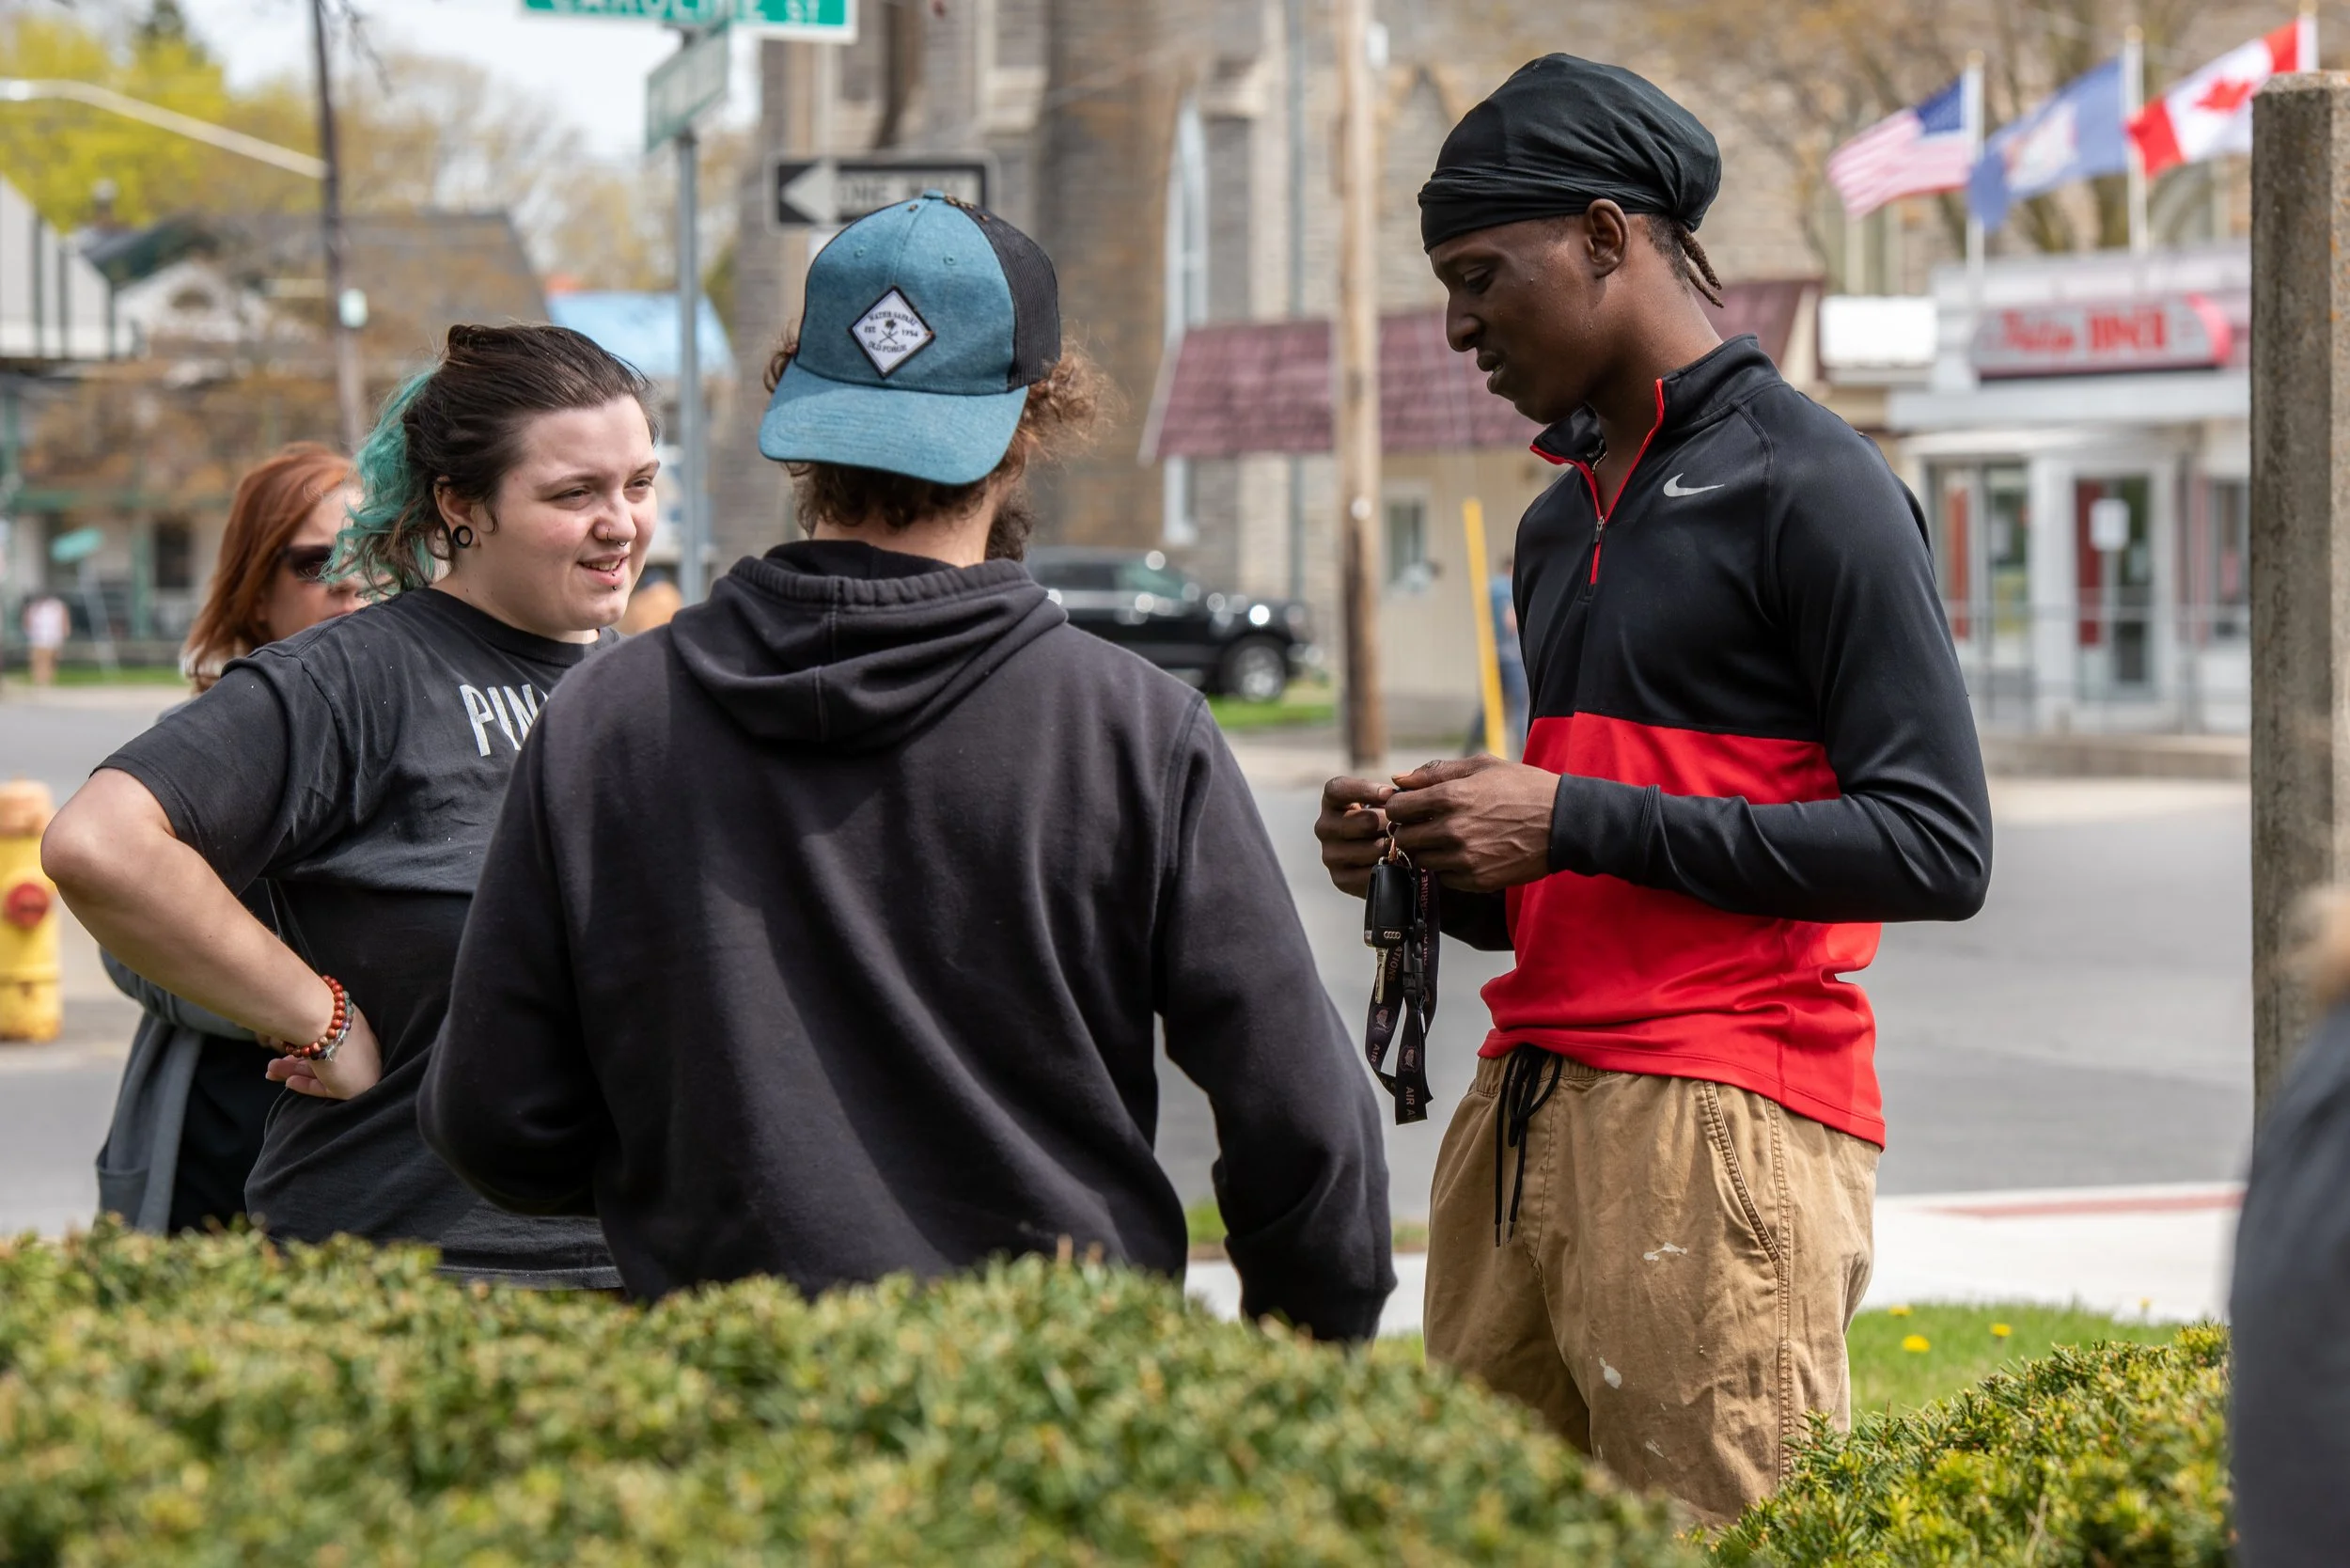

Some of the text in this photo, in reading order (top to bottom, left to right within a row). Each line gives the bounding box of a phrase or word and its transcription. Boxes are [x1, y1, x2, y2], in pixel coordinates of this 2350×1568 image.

[868, 311, 891, 321] WATER
[868, 340, 907, 353] OLD FORGE
[459, 683, 550, 757] PIN
[1420, 874, 1429, 913] ARINE
[1371, 1043, 1381, 1062] AIR
[1406, 1086, 1416, 1105] AIR
